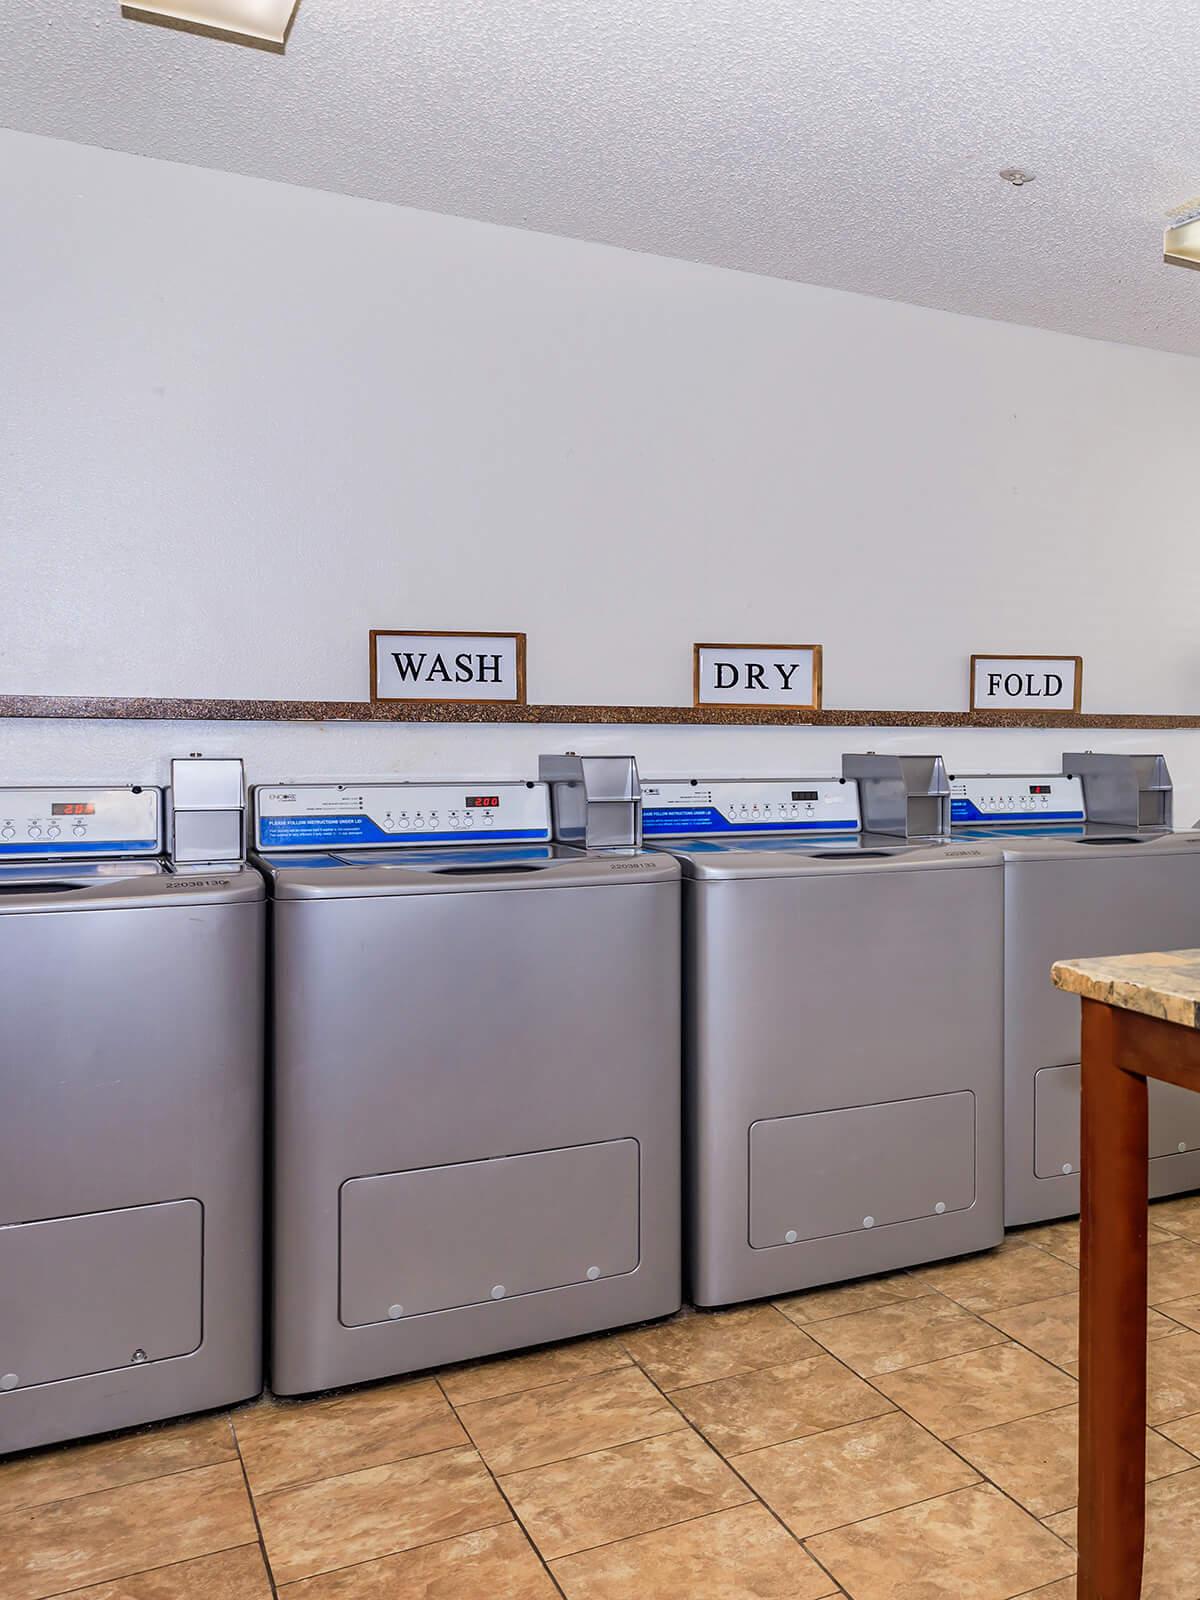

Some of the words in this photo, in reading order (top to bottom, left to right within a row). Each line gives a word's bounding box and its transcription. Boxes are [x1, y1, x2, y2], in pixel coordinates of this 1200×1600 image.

[391, 652, 503, 683] WASH
[713, 662, 800, 690] DRY
[986, 673, 1063, 696] FOLD
[475, 798, 498, 806] 200
